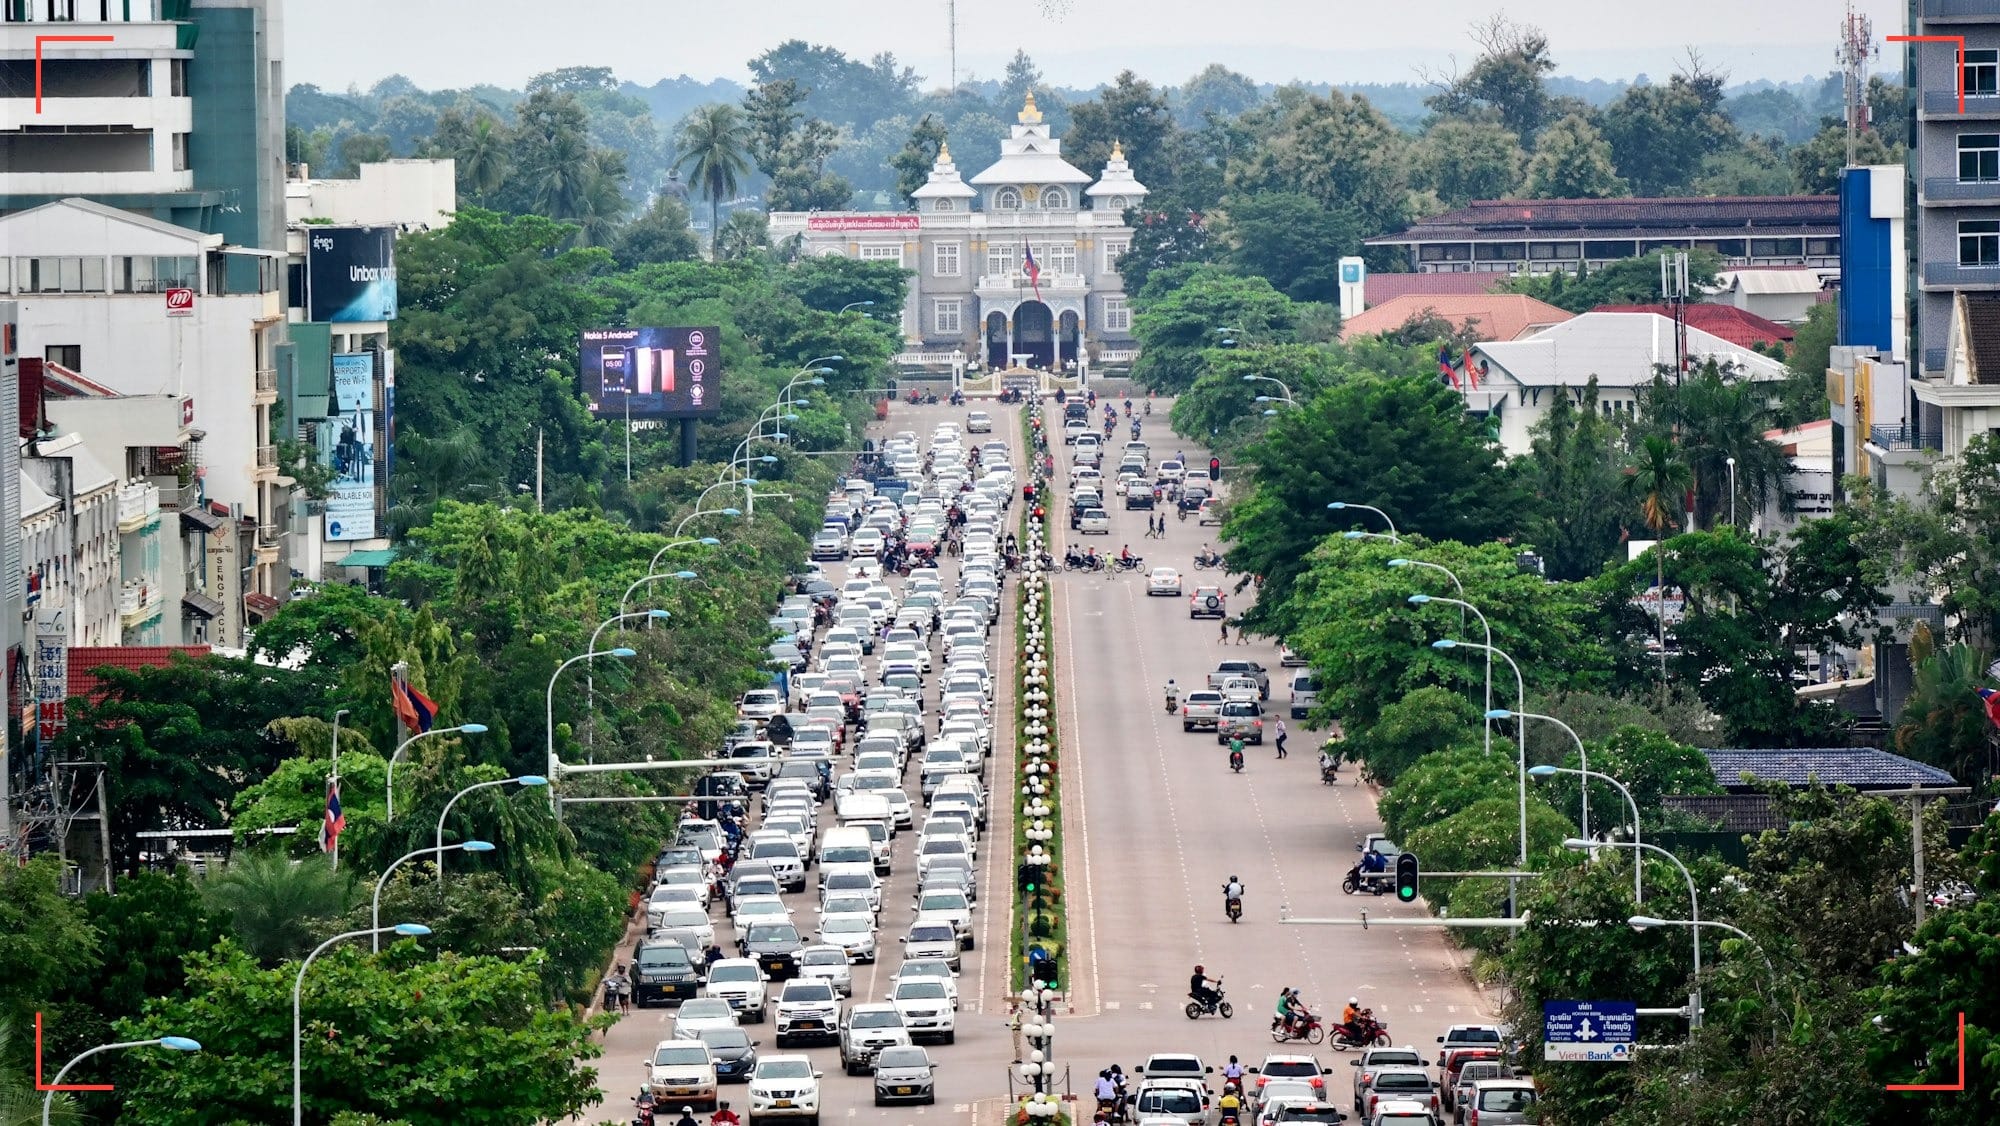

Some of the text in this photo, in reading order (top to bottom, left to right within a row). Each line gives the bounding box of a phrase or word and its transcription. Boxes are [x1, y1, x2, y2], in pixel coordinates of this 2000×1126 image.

[350, 265, 379, 282] Unbox
[584, 331, 602, 340] Nokia
[605, 360, 622, 368] 05:00
[335, 366, 361, 375] AIRPORT
[334, 375, 351, 386] Free
[40, 701, 64, 721] MI
[1558, 1051, 1613, 1060] VietinBank
